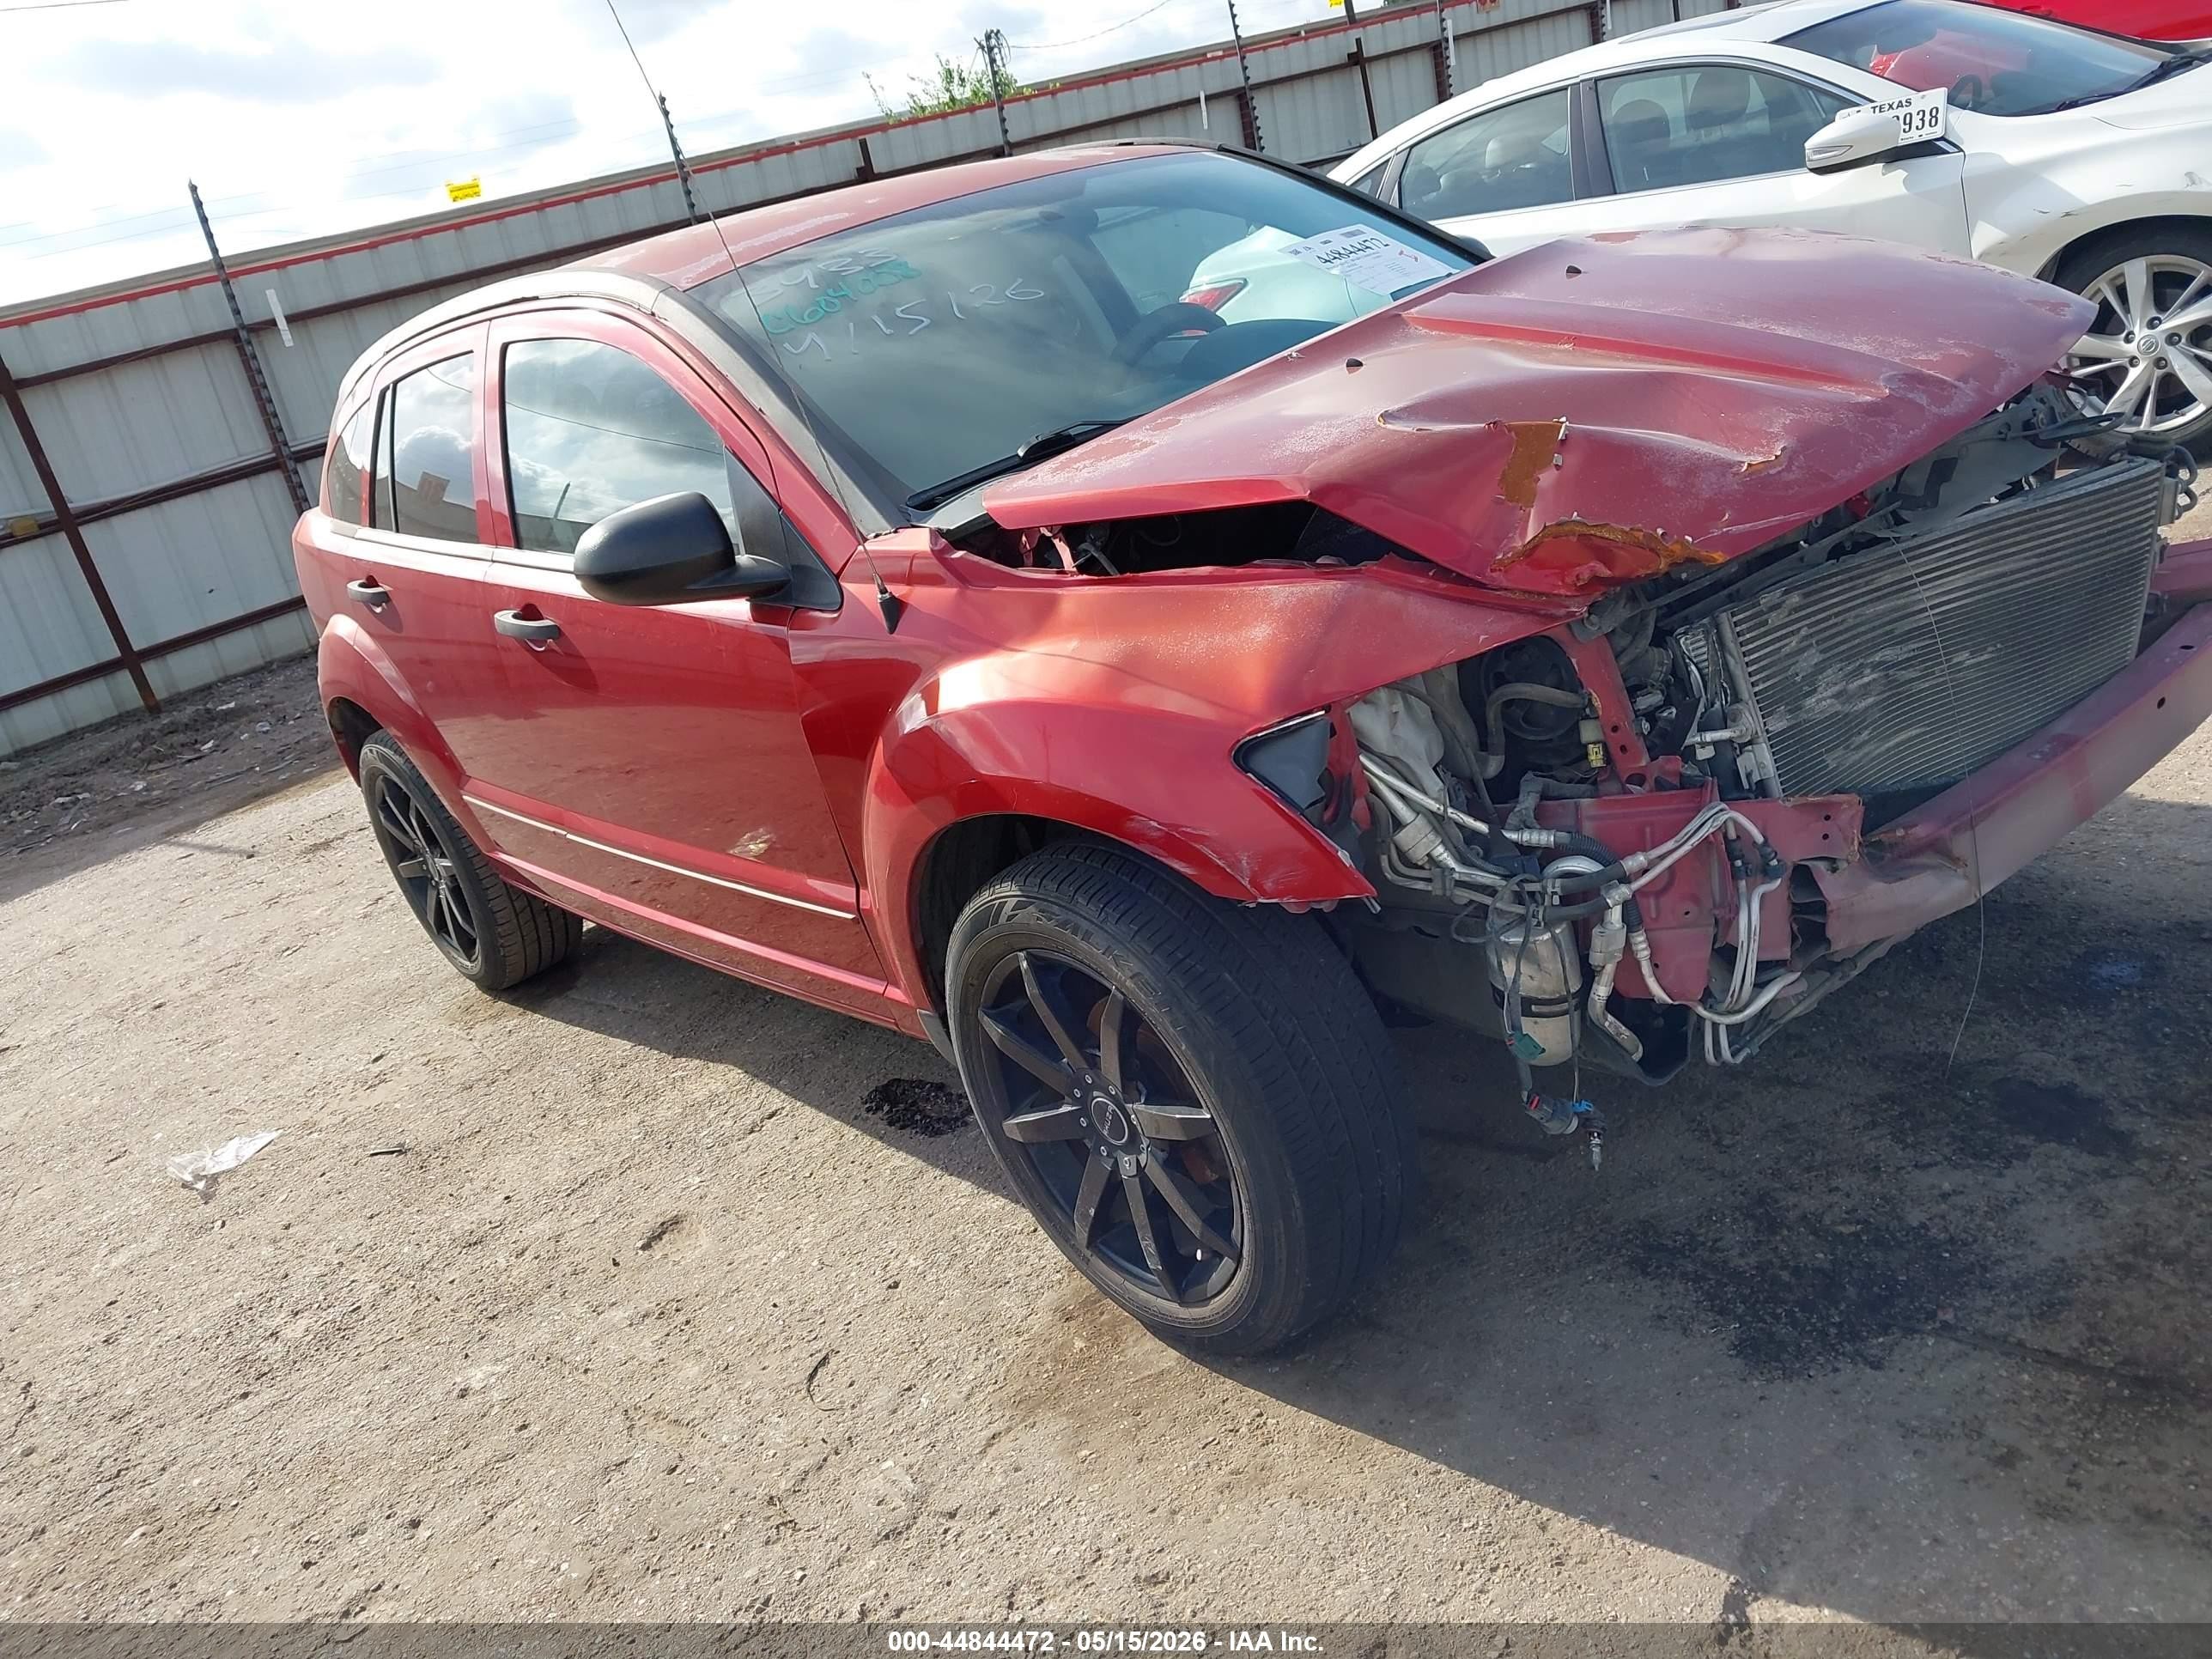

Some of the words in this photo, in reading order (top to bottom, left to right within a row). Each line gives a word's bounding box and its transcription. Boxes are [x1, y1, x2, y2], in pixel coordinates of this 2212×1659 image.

[1870, 98, 1913, 114] TEXAS
[1892, 106, 1940, 133] 938
[1316, 238, 1389, 265] 44844472
